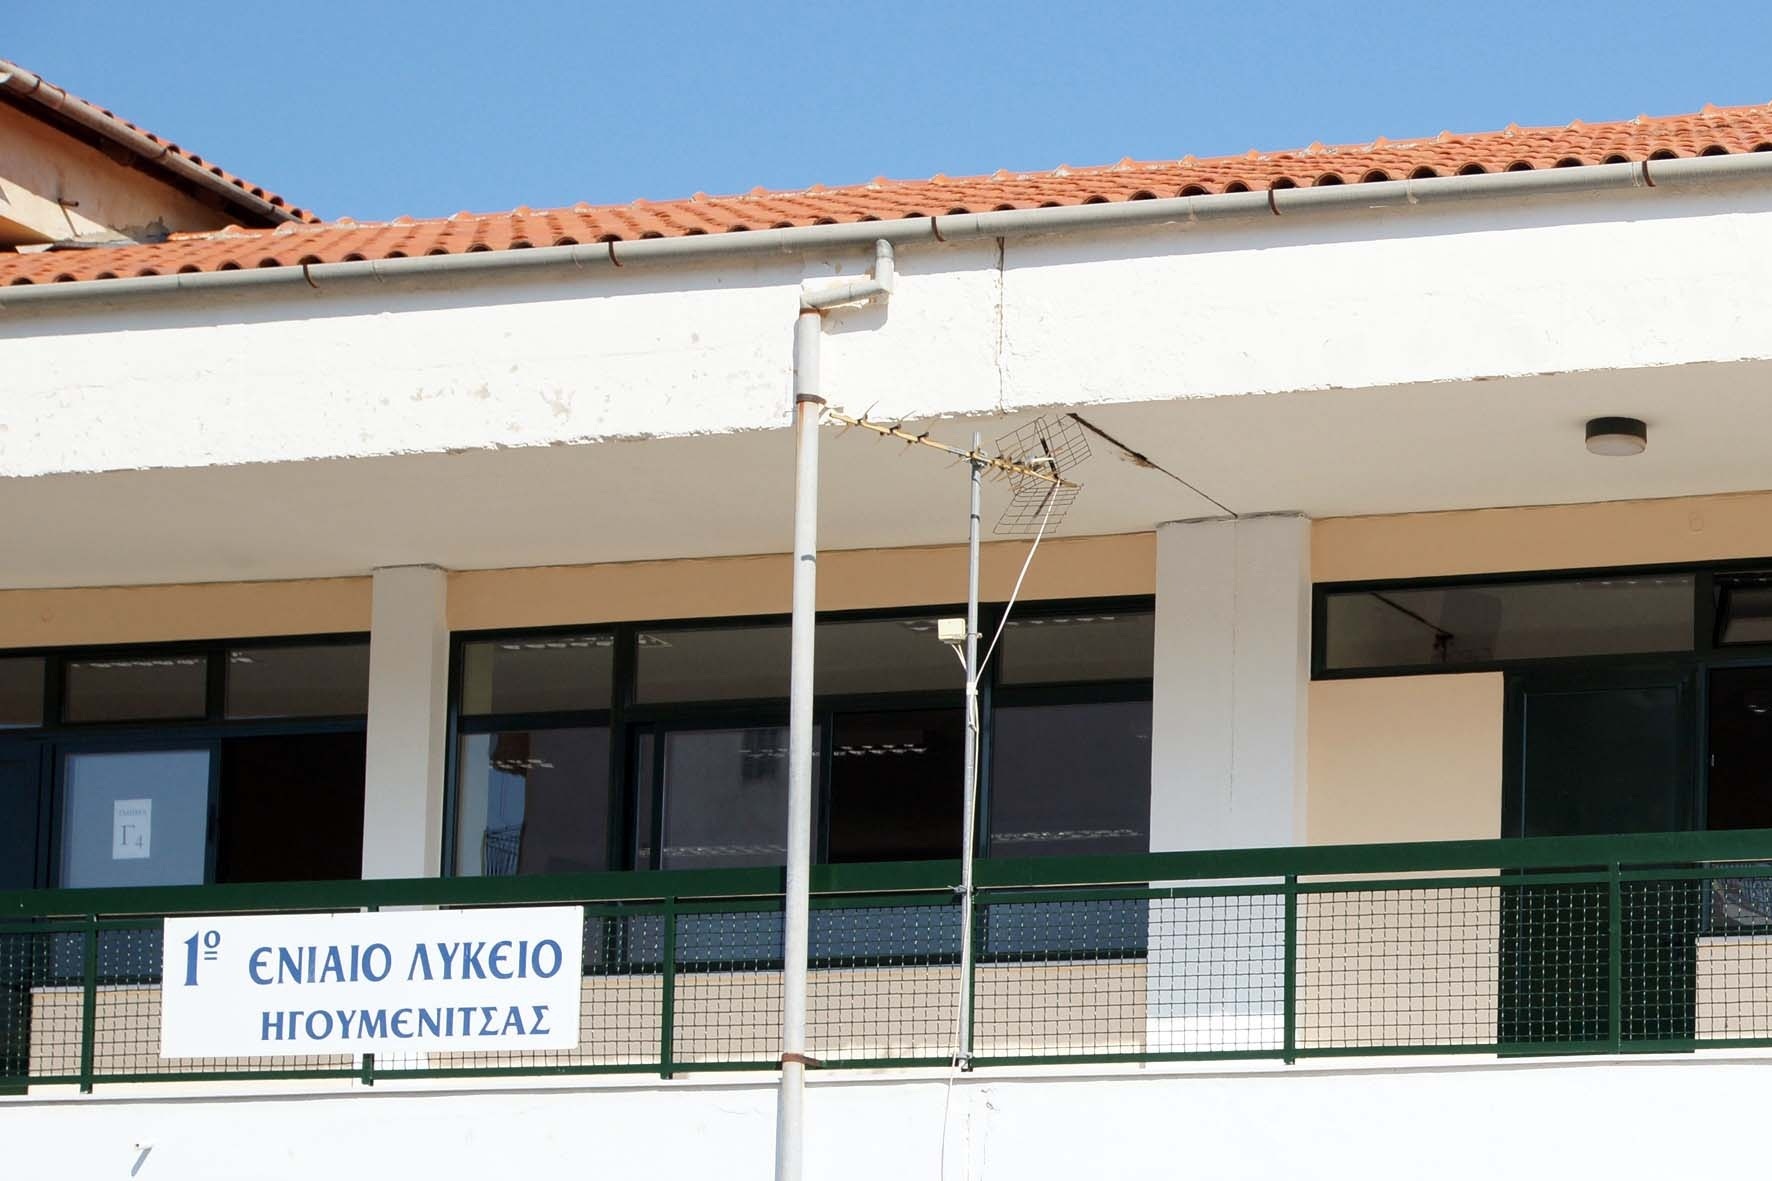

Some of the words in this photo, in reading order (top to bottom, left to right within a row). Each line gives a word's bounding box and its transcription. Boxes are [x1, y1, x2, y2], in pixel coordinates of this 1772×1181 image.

[248, 943, 392, 986] ΕΝΙΑΙΟ
[408, 938, 563, 981] ΛΥΚΕΙΟ
[260, 1005, 550, 1041] ΗΓΟΥΜΕΝΙΤΣΑΣ
